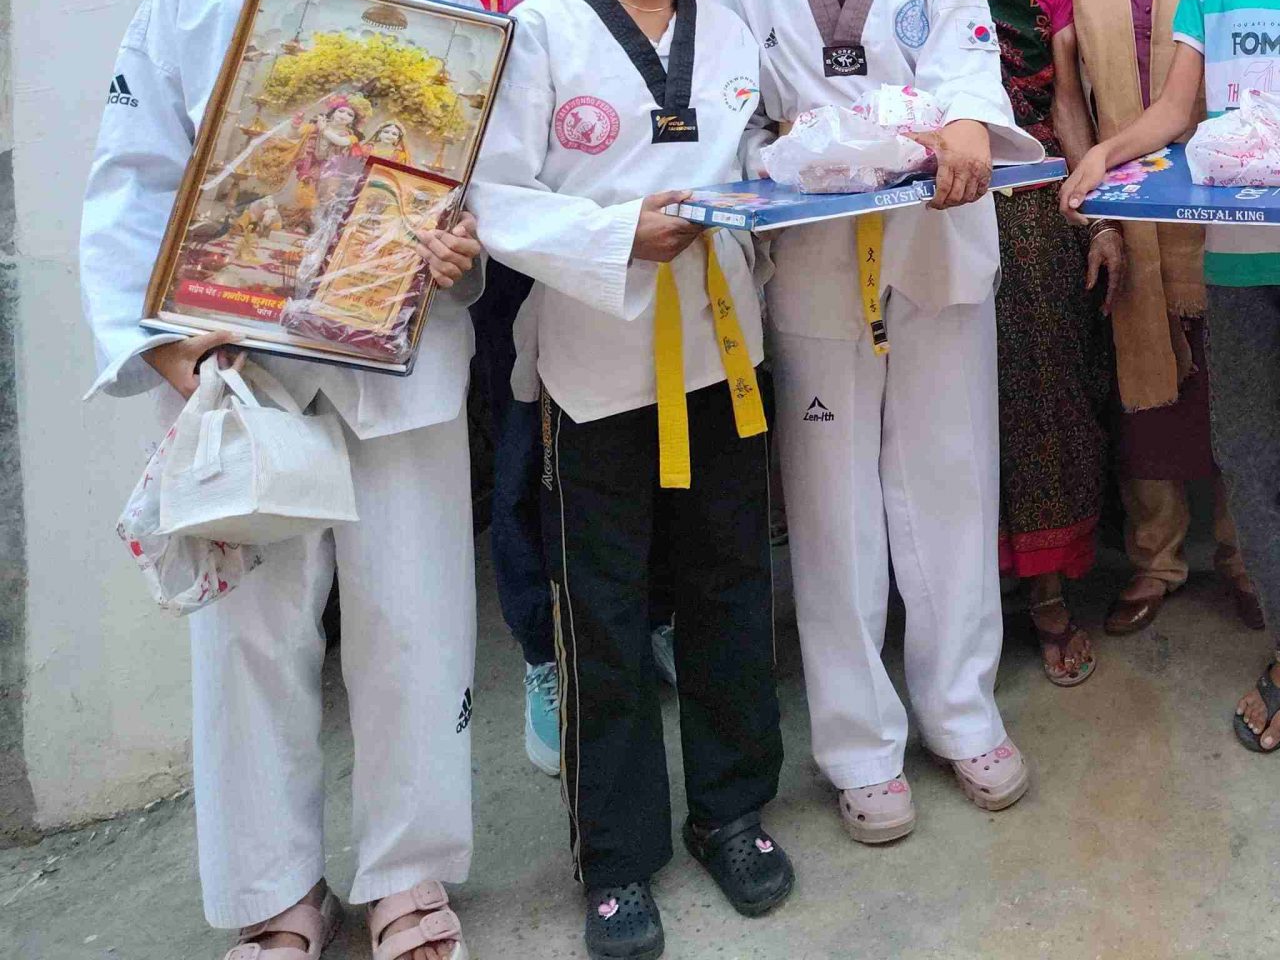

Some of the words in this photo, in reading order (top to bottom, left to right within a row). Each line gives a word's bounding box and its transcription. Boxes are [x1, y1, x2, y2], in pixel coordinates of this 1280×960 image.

[106, 93, 140, 108] idas
[1176, 208, 1233, 221] CRYSTAL
[1235, 210, 1265, 222] KING
